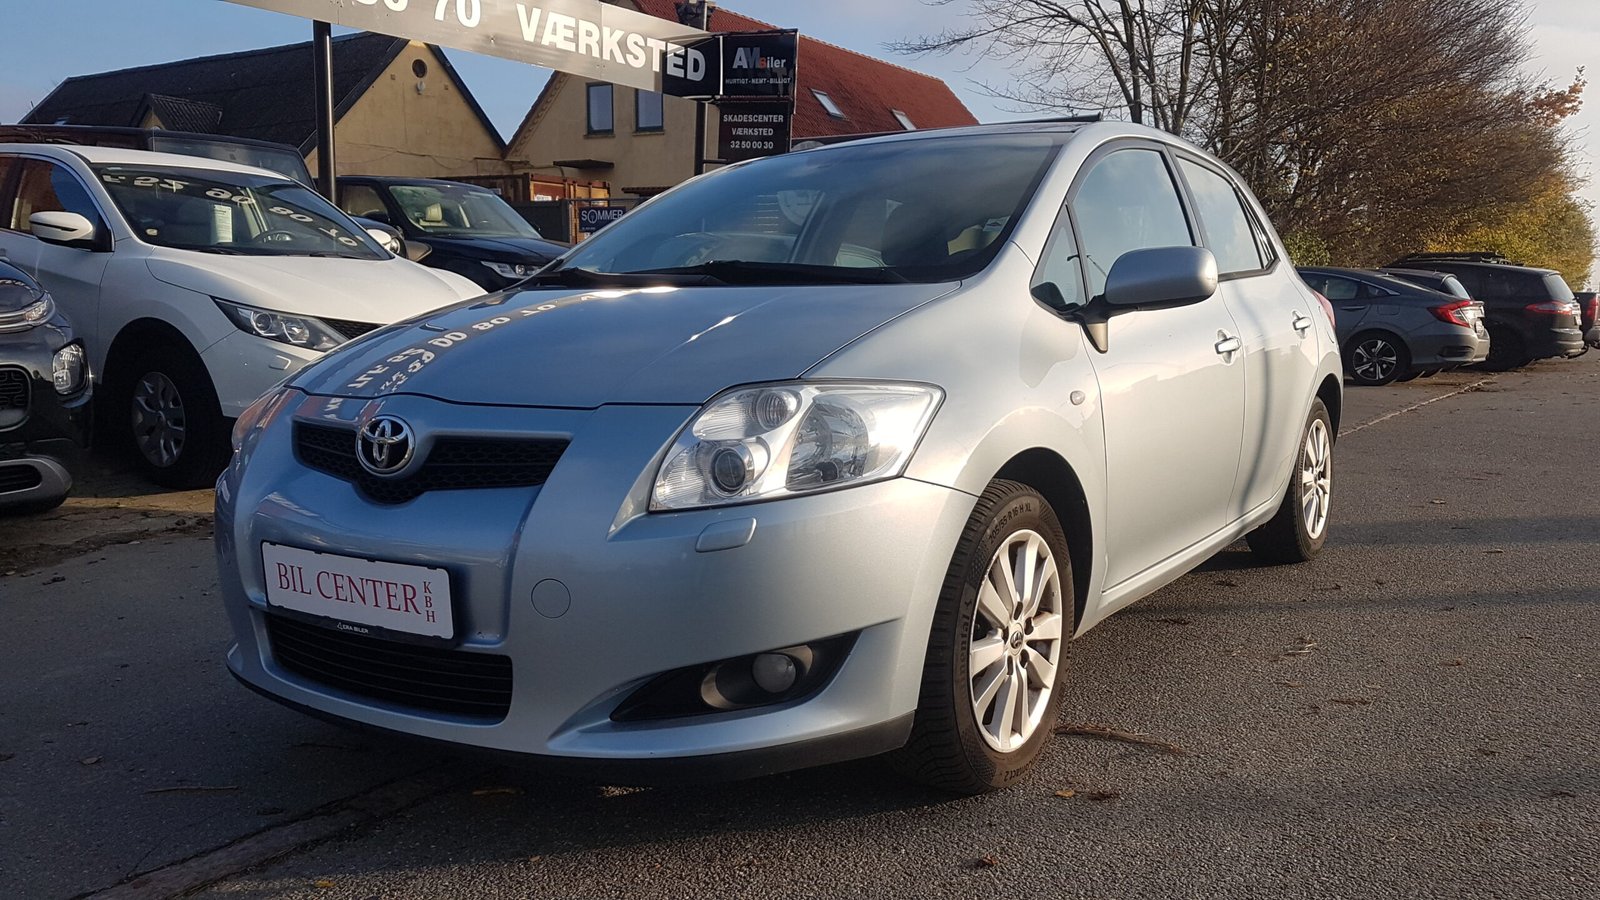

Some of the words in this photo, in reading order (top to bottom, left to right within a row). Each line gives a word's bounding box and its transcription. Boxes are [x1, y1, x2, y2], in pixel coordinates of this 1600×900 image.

[516, 3, 706, 82] VÆRKSTED
[723, 114, 784, 123] SKADESCENTER
[731, 127, 774, 136] VÆRKSTED
[581, 209, 624, 224] SOMMER
[276, 562, 312, 595] BIL
[316, 571, 422, 615] CENTER
